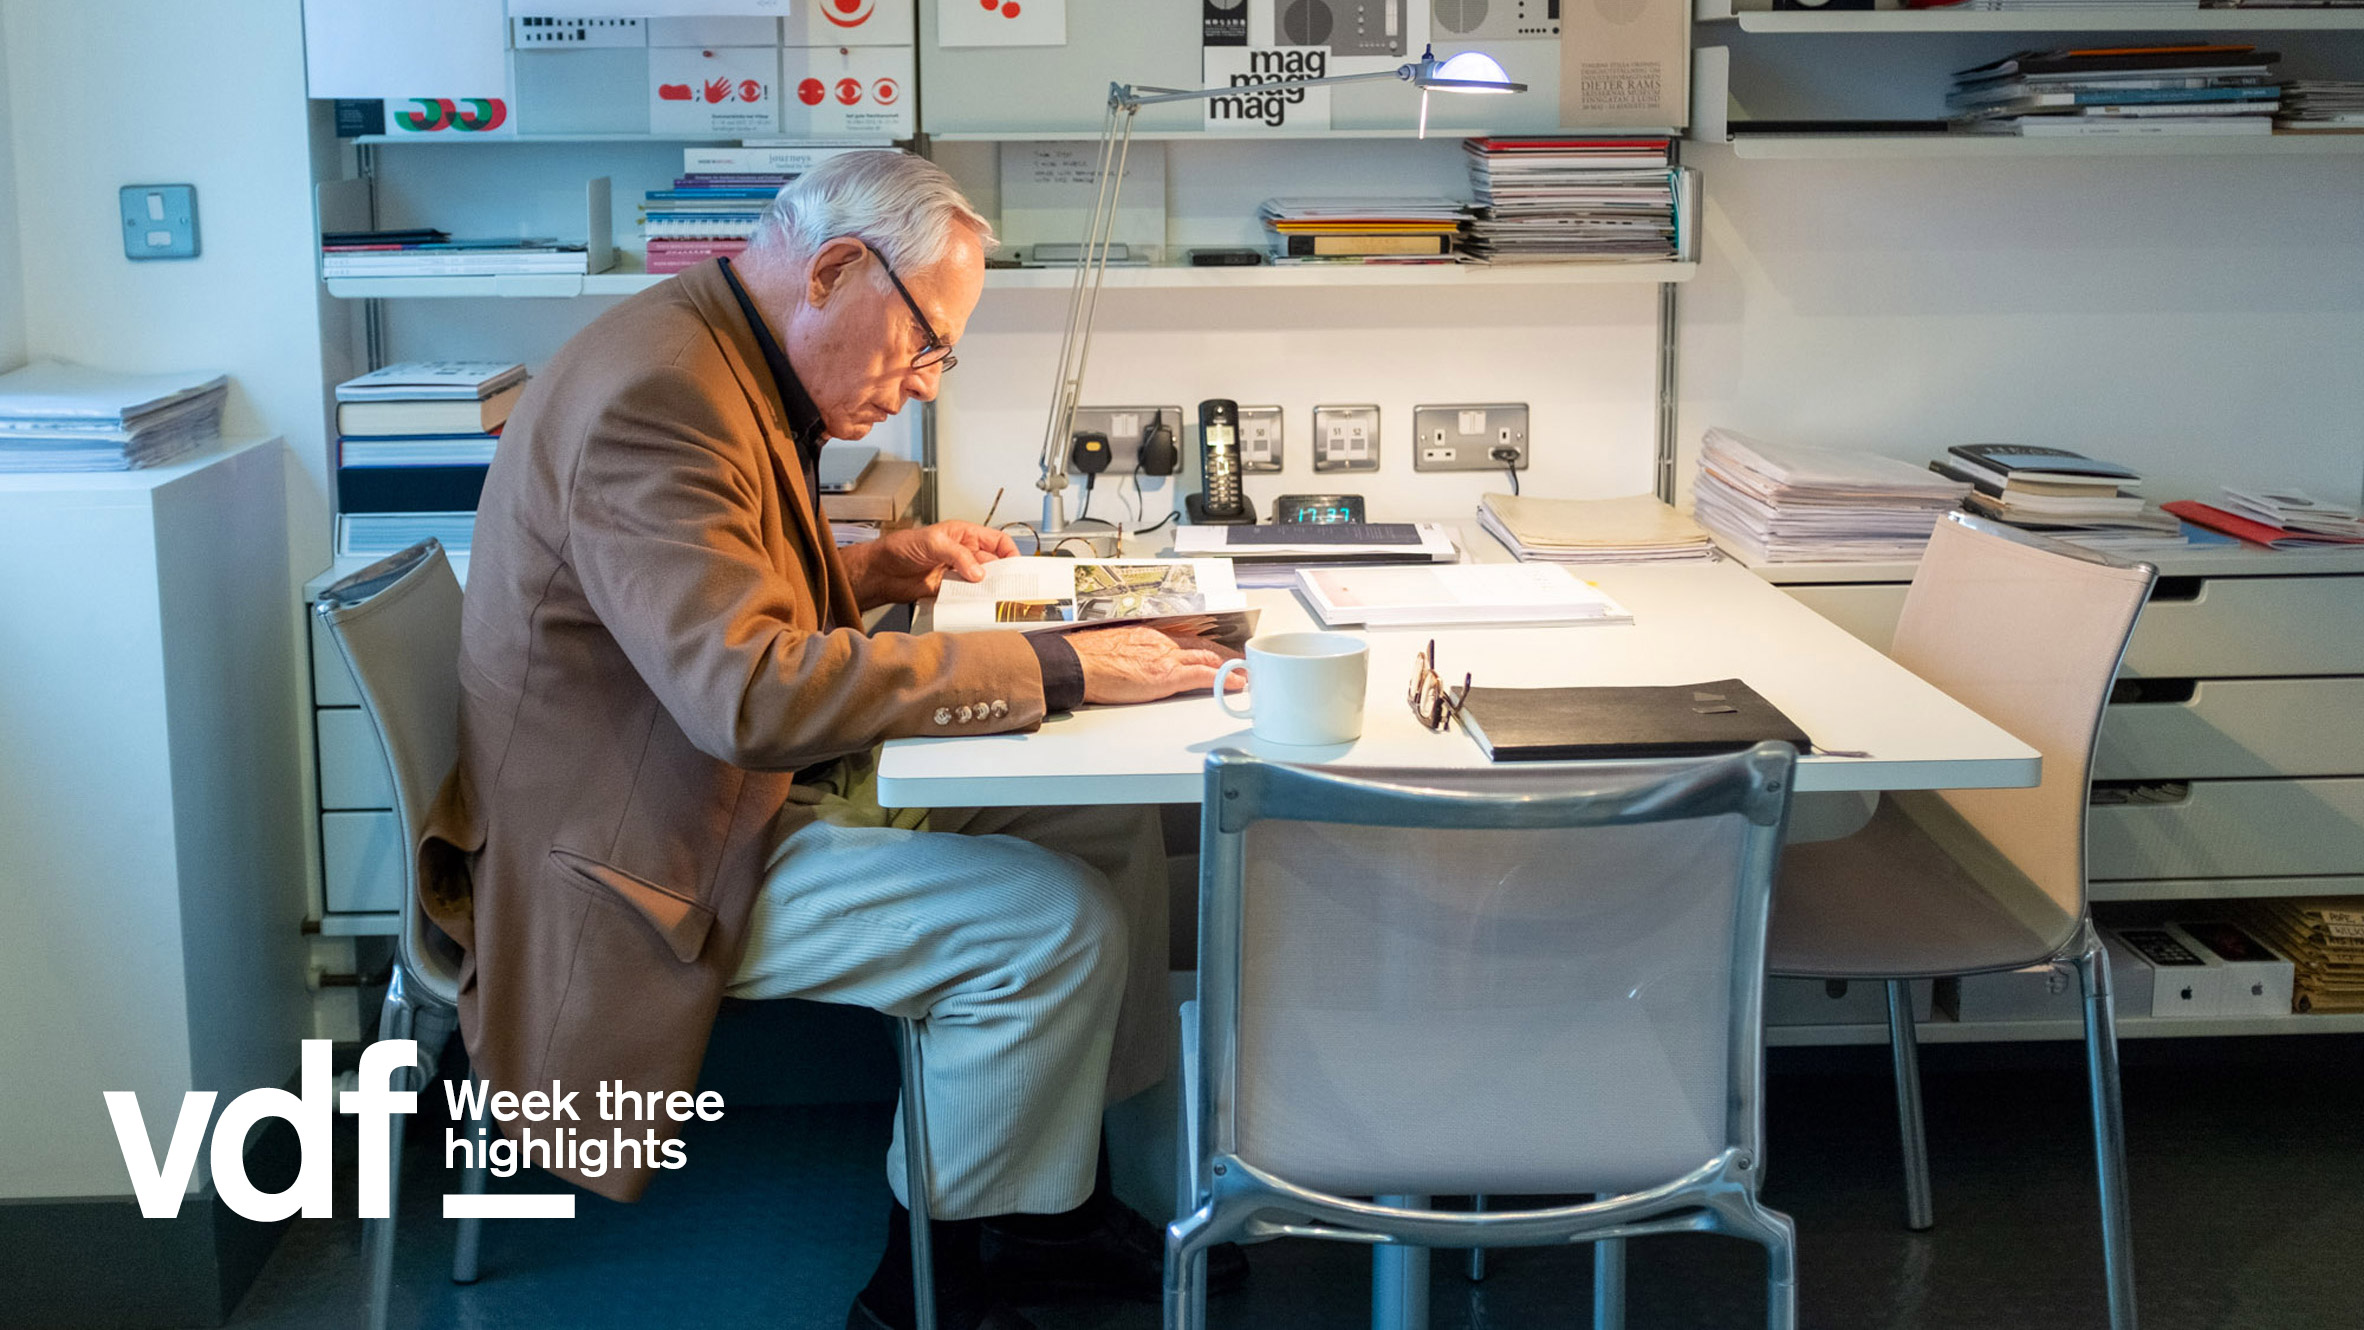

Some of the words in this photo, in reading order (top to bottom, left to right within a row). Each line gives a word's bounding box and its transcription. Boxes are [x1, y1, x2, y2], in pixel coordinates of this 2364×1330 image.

[1250, 51, 1326, 80] mag
[1230, 73, 1305, 104] mag
[1581, 81, 1624, 91] DIETER
[1627, 80, 1662, 90] RAMS
[1210, 96, 1285, 127] mag
